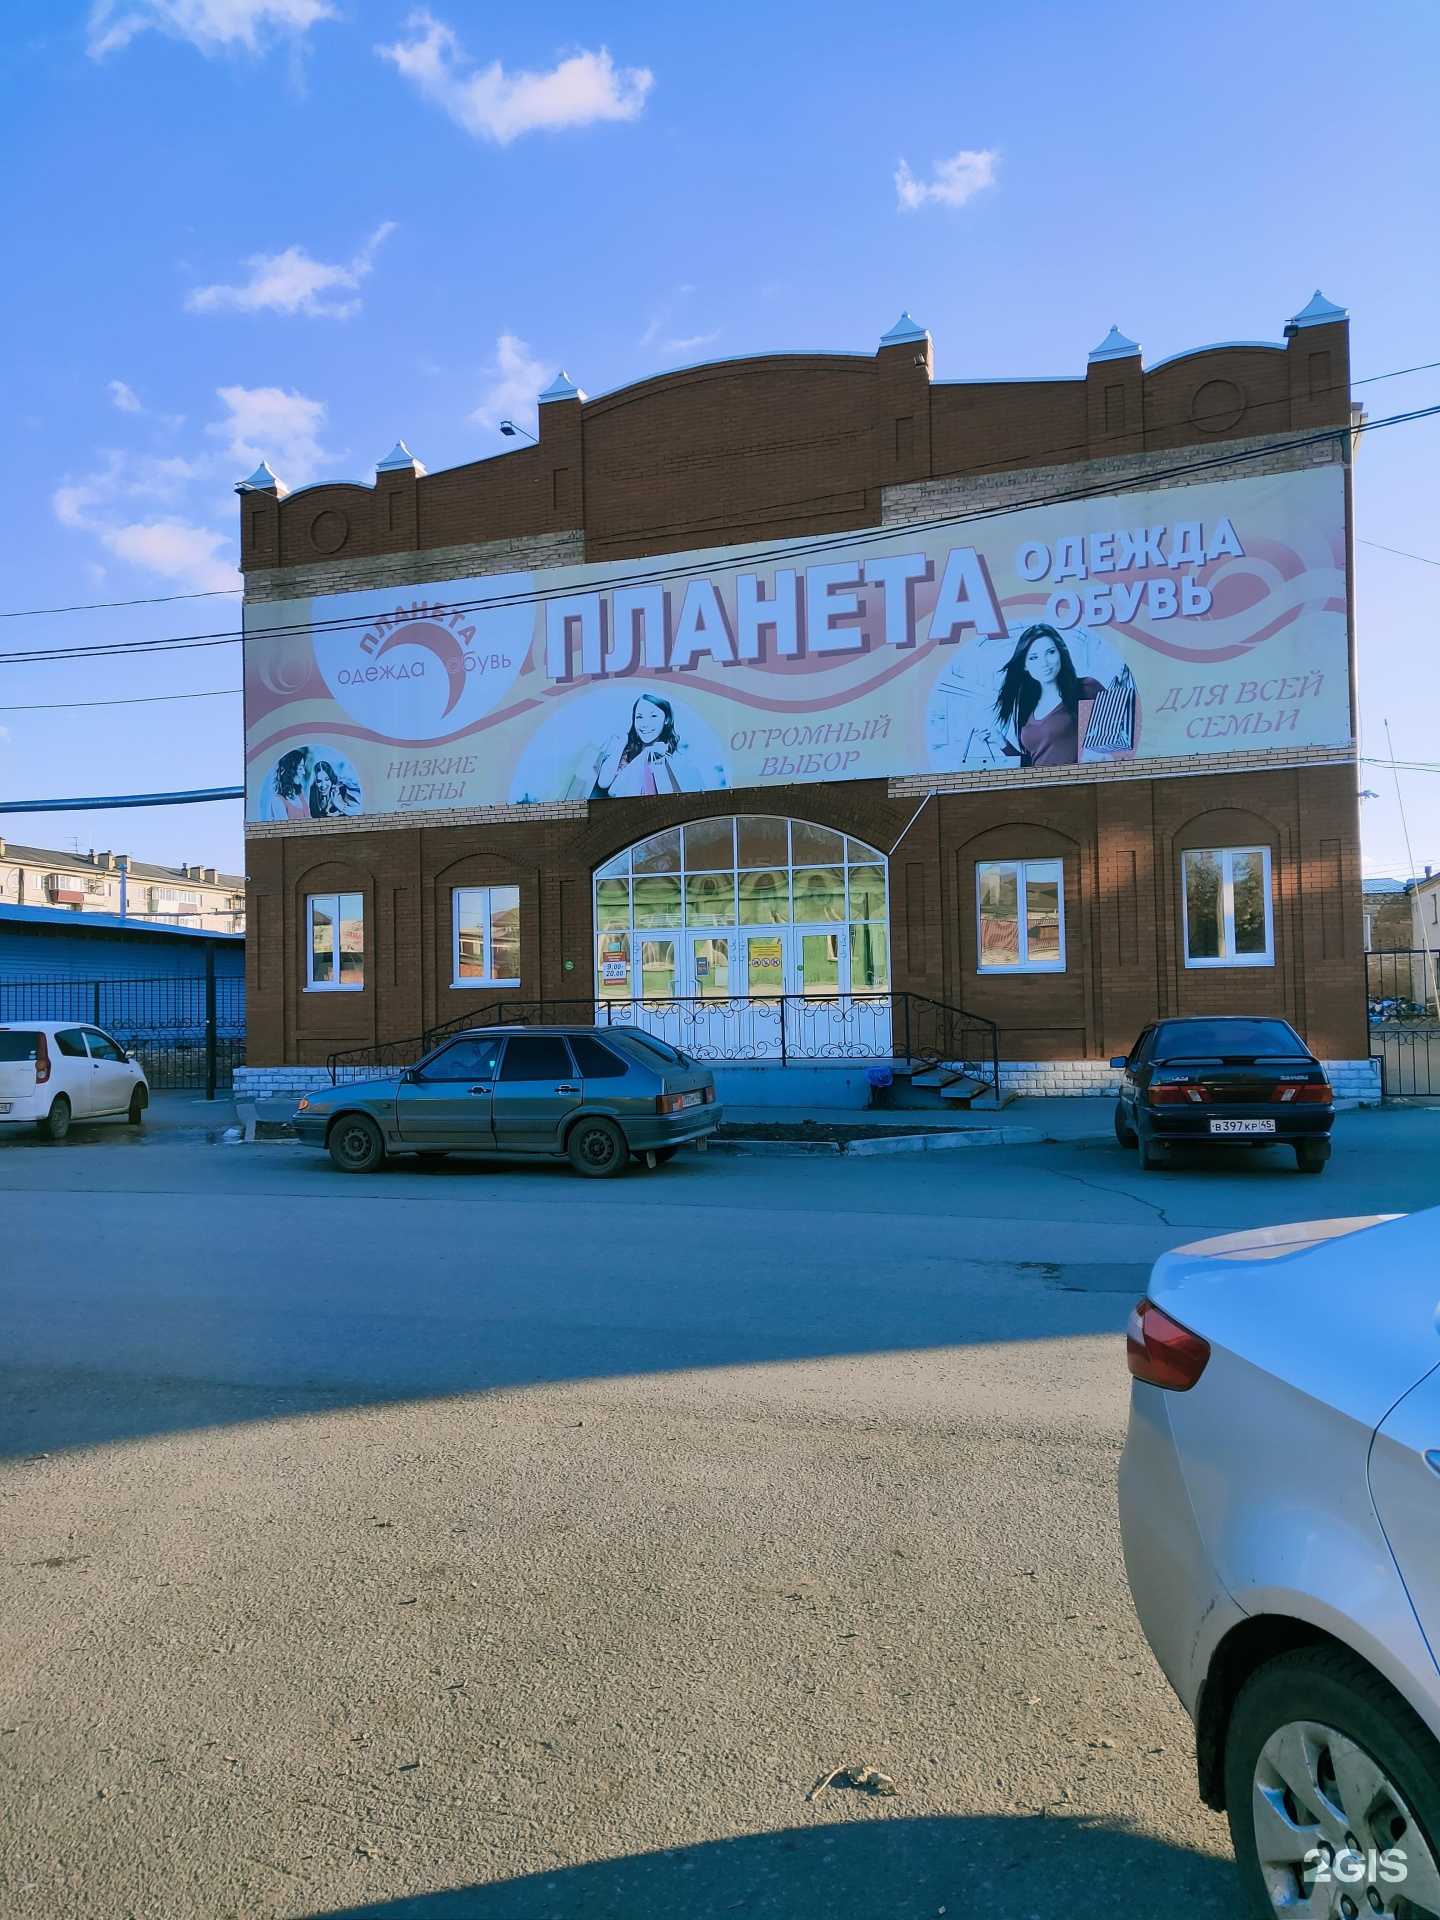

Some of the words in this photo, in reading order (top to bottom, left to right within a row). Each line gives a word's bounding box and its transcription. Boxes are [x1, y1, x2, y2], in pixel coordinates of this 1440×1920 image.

[1016, 516, 1246, 583] ОДЕЖДА
[545, 545, 1009, 683] ПЛАНЕТА
[1046, 575, 1213, 630] ОБУВЬ
[359, 600, 477, 655] ПЛАНЕТА
[338, 661, 425, 686] одежда
[1156, 684, 1229, 713] ДЛЯ
[1235, 669, 1325, 704] ВСЕЙ
[730, 714, 893, 750] ОГРОМНЫЙ
[1186, 708, 1300, 738] СЕМЬИ
[385, 755, 478, 779] НИЗКИЕ
[759, 750, 861, 777] ВЫБОР
[397, 781, 466, 808] ЦЕНЫ
